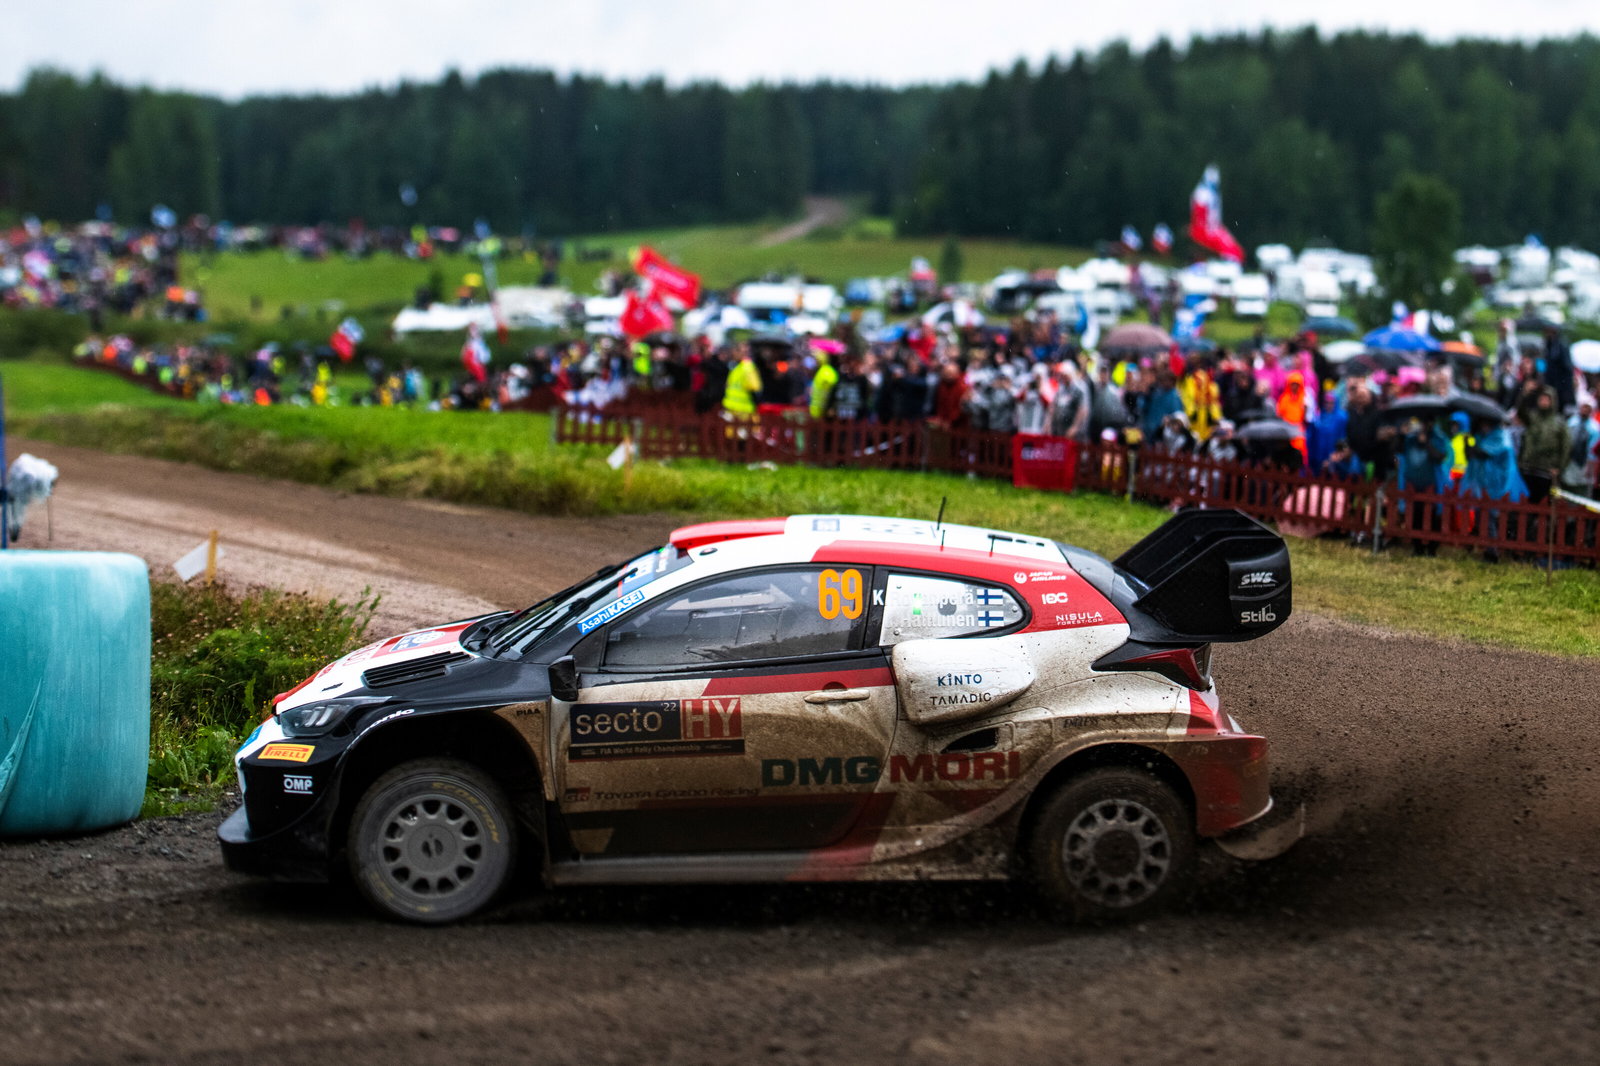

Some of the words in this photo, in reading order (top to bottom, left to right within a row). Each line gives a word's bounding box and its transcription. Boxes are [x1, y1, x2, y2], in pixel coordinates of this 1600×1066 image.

[1241, 572, 1274, 585] SWS
[818, 569, 863, 620] 69
[1055, 611, 1102, 621] NISULA
[1241, 604, 1277, 623] Stilo
[929, 692, 992, 706] TAMADIC
[575, 708, 663, 736] secto
[685, 698, 740, 738] HY
[264, 746, 310, 759] PIRELLI
[761, 756, 880, 787] DMG
[889, 751, 1021, 784] MORI
[283, 777, 313, 791] OMP
